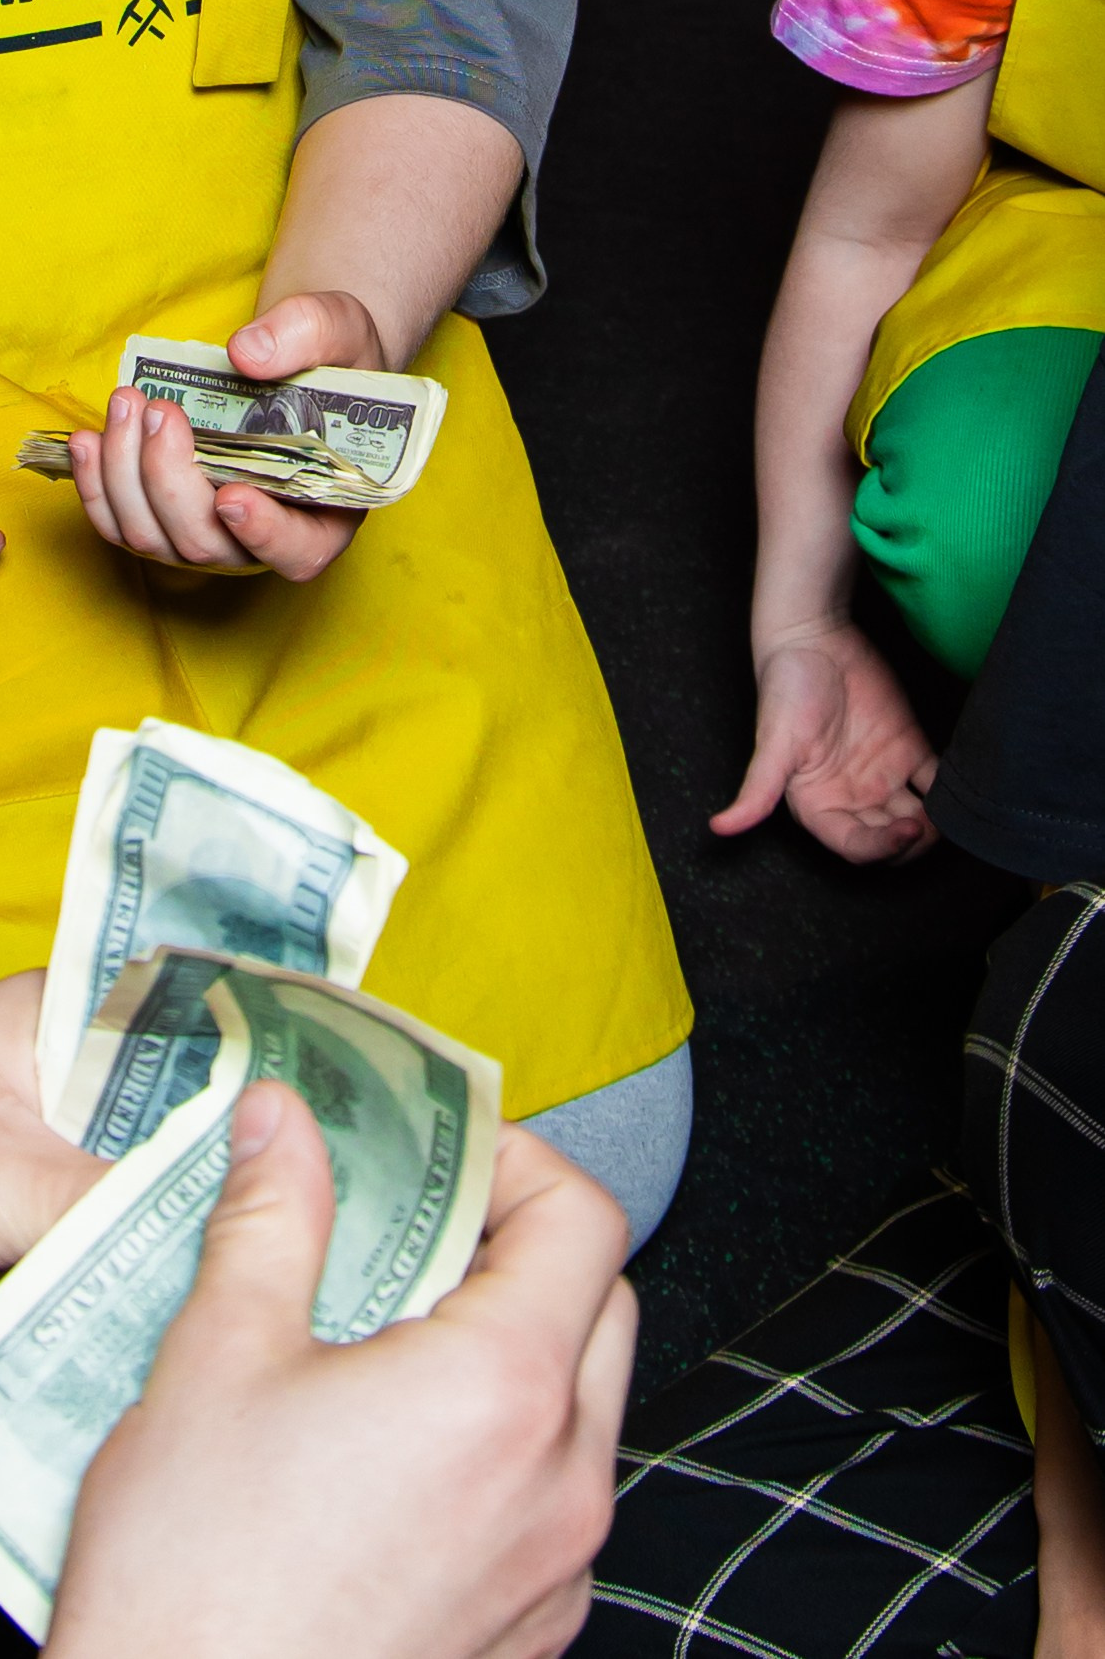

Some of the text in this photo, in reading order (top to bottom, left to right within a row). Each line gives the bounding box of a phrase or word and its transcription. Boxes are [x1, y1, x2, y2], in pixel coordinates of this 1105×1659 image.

[142, 364, 191, 381] DOLLARS
[191, 374, 240, 391] HUNDRED
[346, 401, 404, 430] 100
[31, 1214, 162, 1346] DOLLARS
